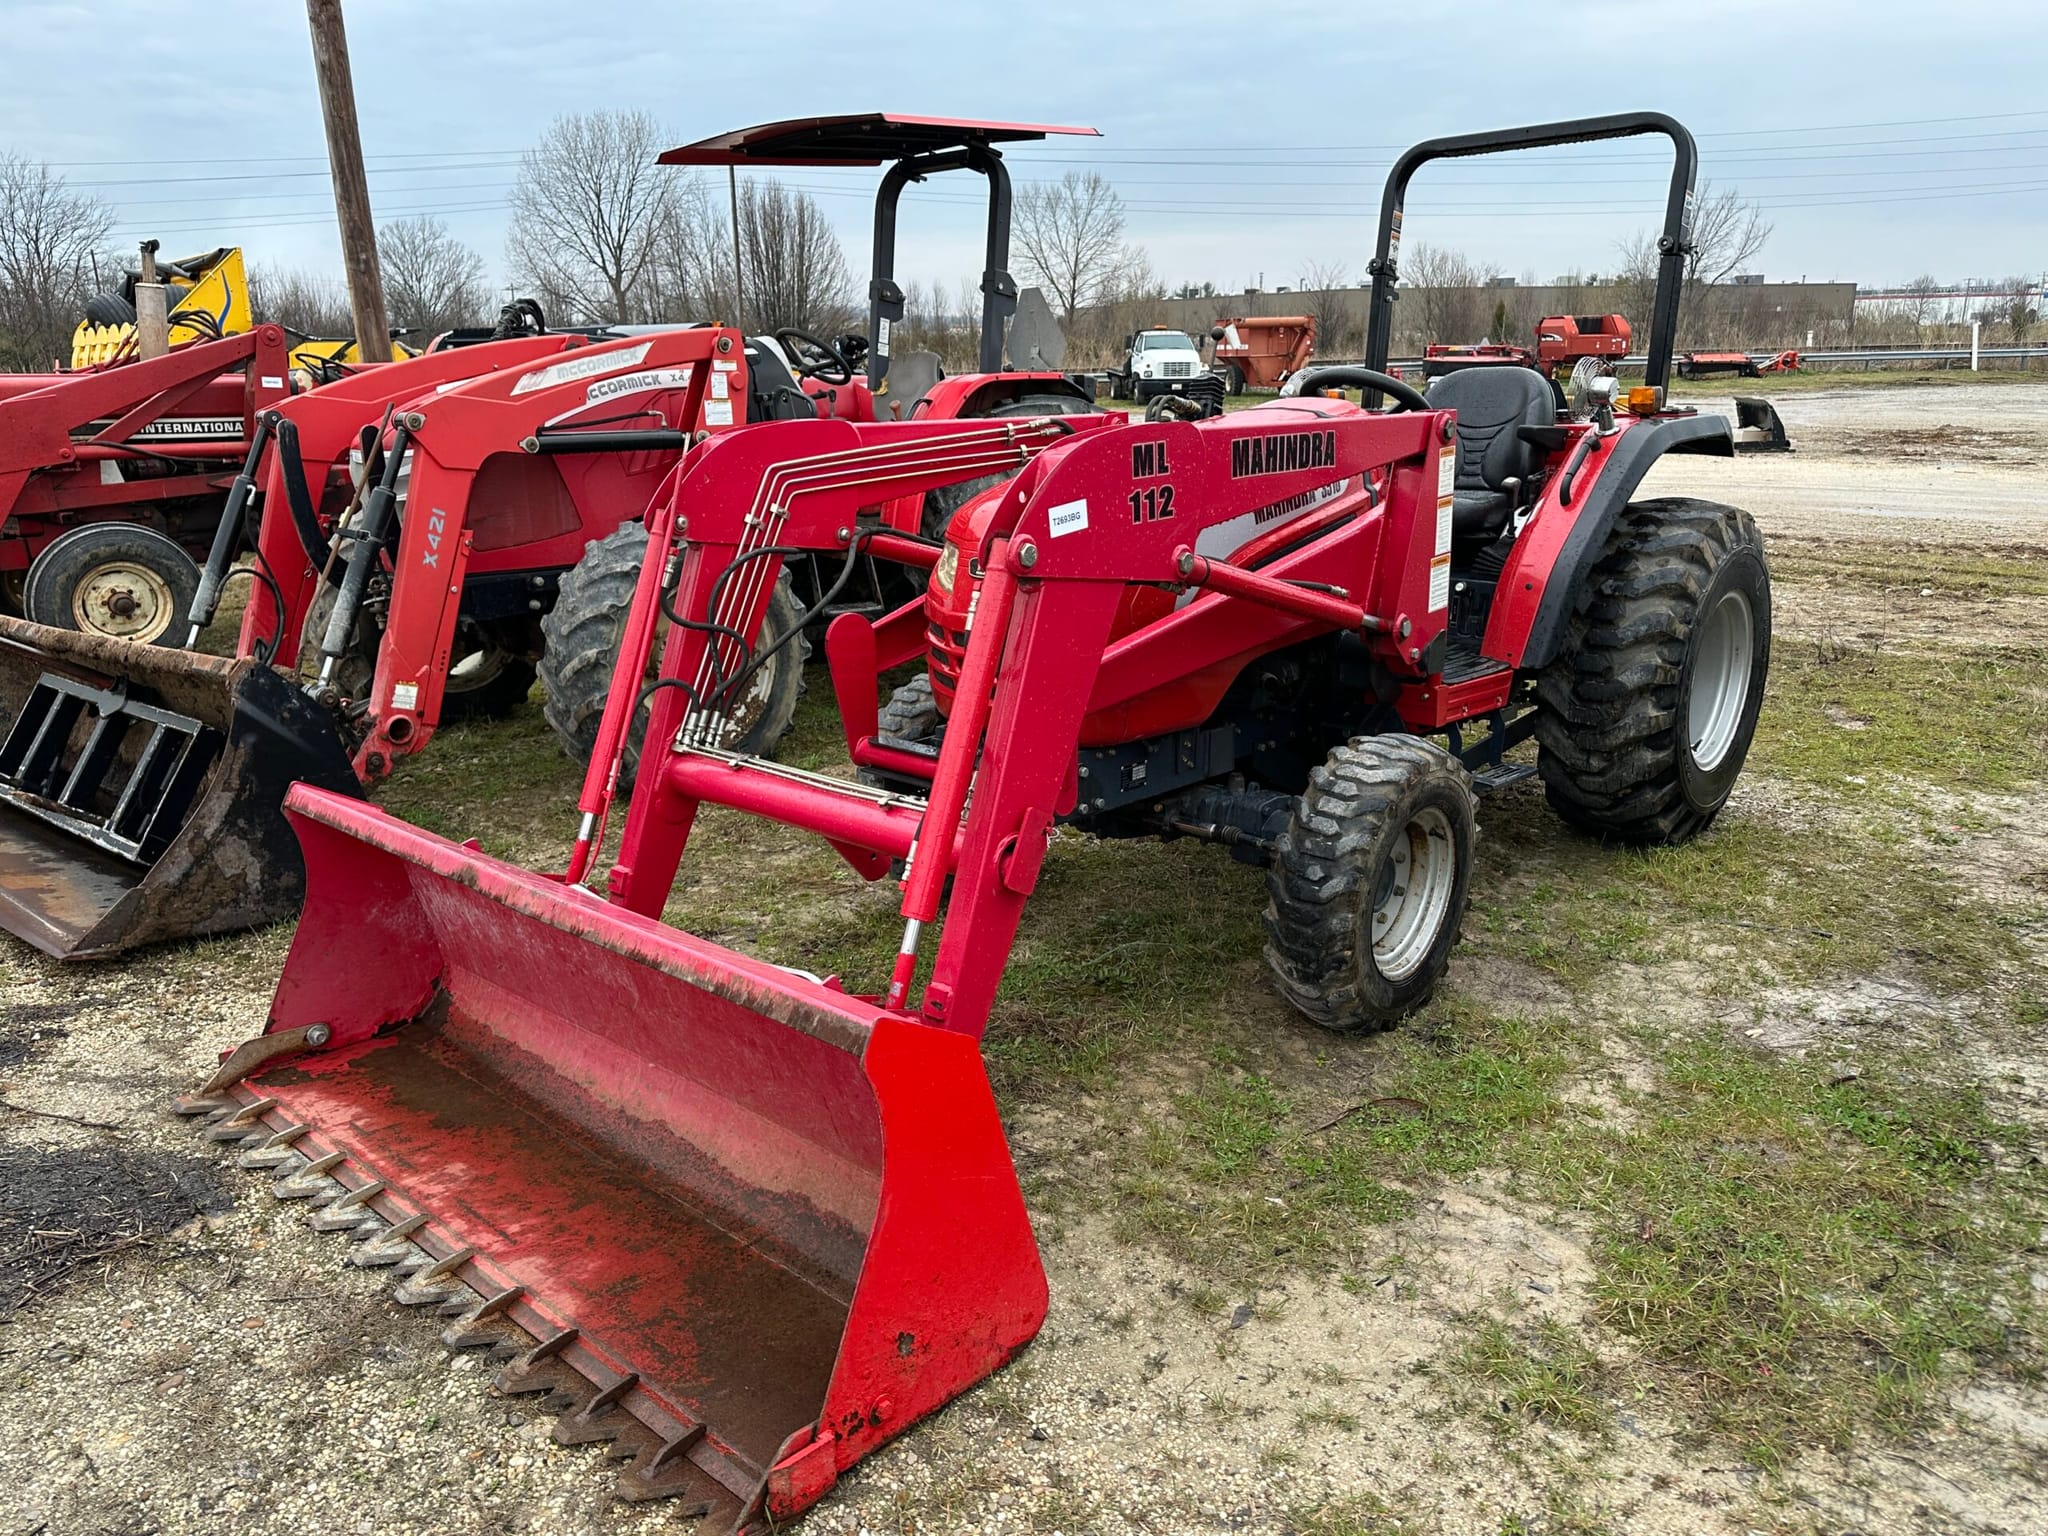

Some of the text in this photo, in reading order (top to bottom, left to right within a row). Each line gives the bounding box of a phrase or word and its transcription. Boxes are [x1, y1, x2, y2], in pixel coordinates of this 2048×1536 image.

[140, 422, 246, 434] INTERNATIONA
[1132, 440, 1170, 480] ML
[1231, 430, 1336, 480] MAHINDRA
[1051, 511, 1081, 526] T2693BG
[1128, 484, 1176, 525] 112
[423, 508, 446, 569] X421
